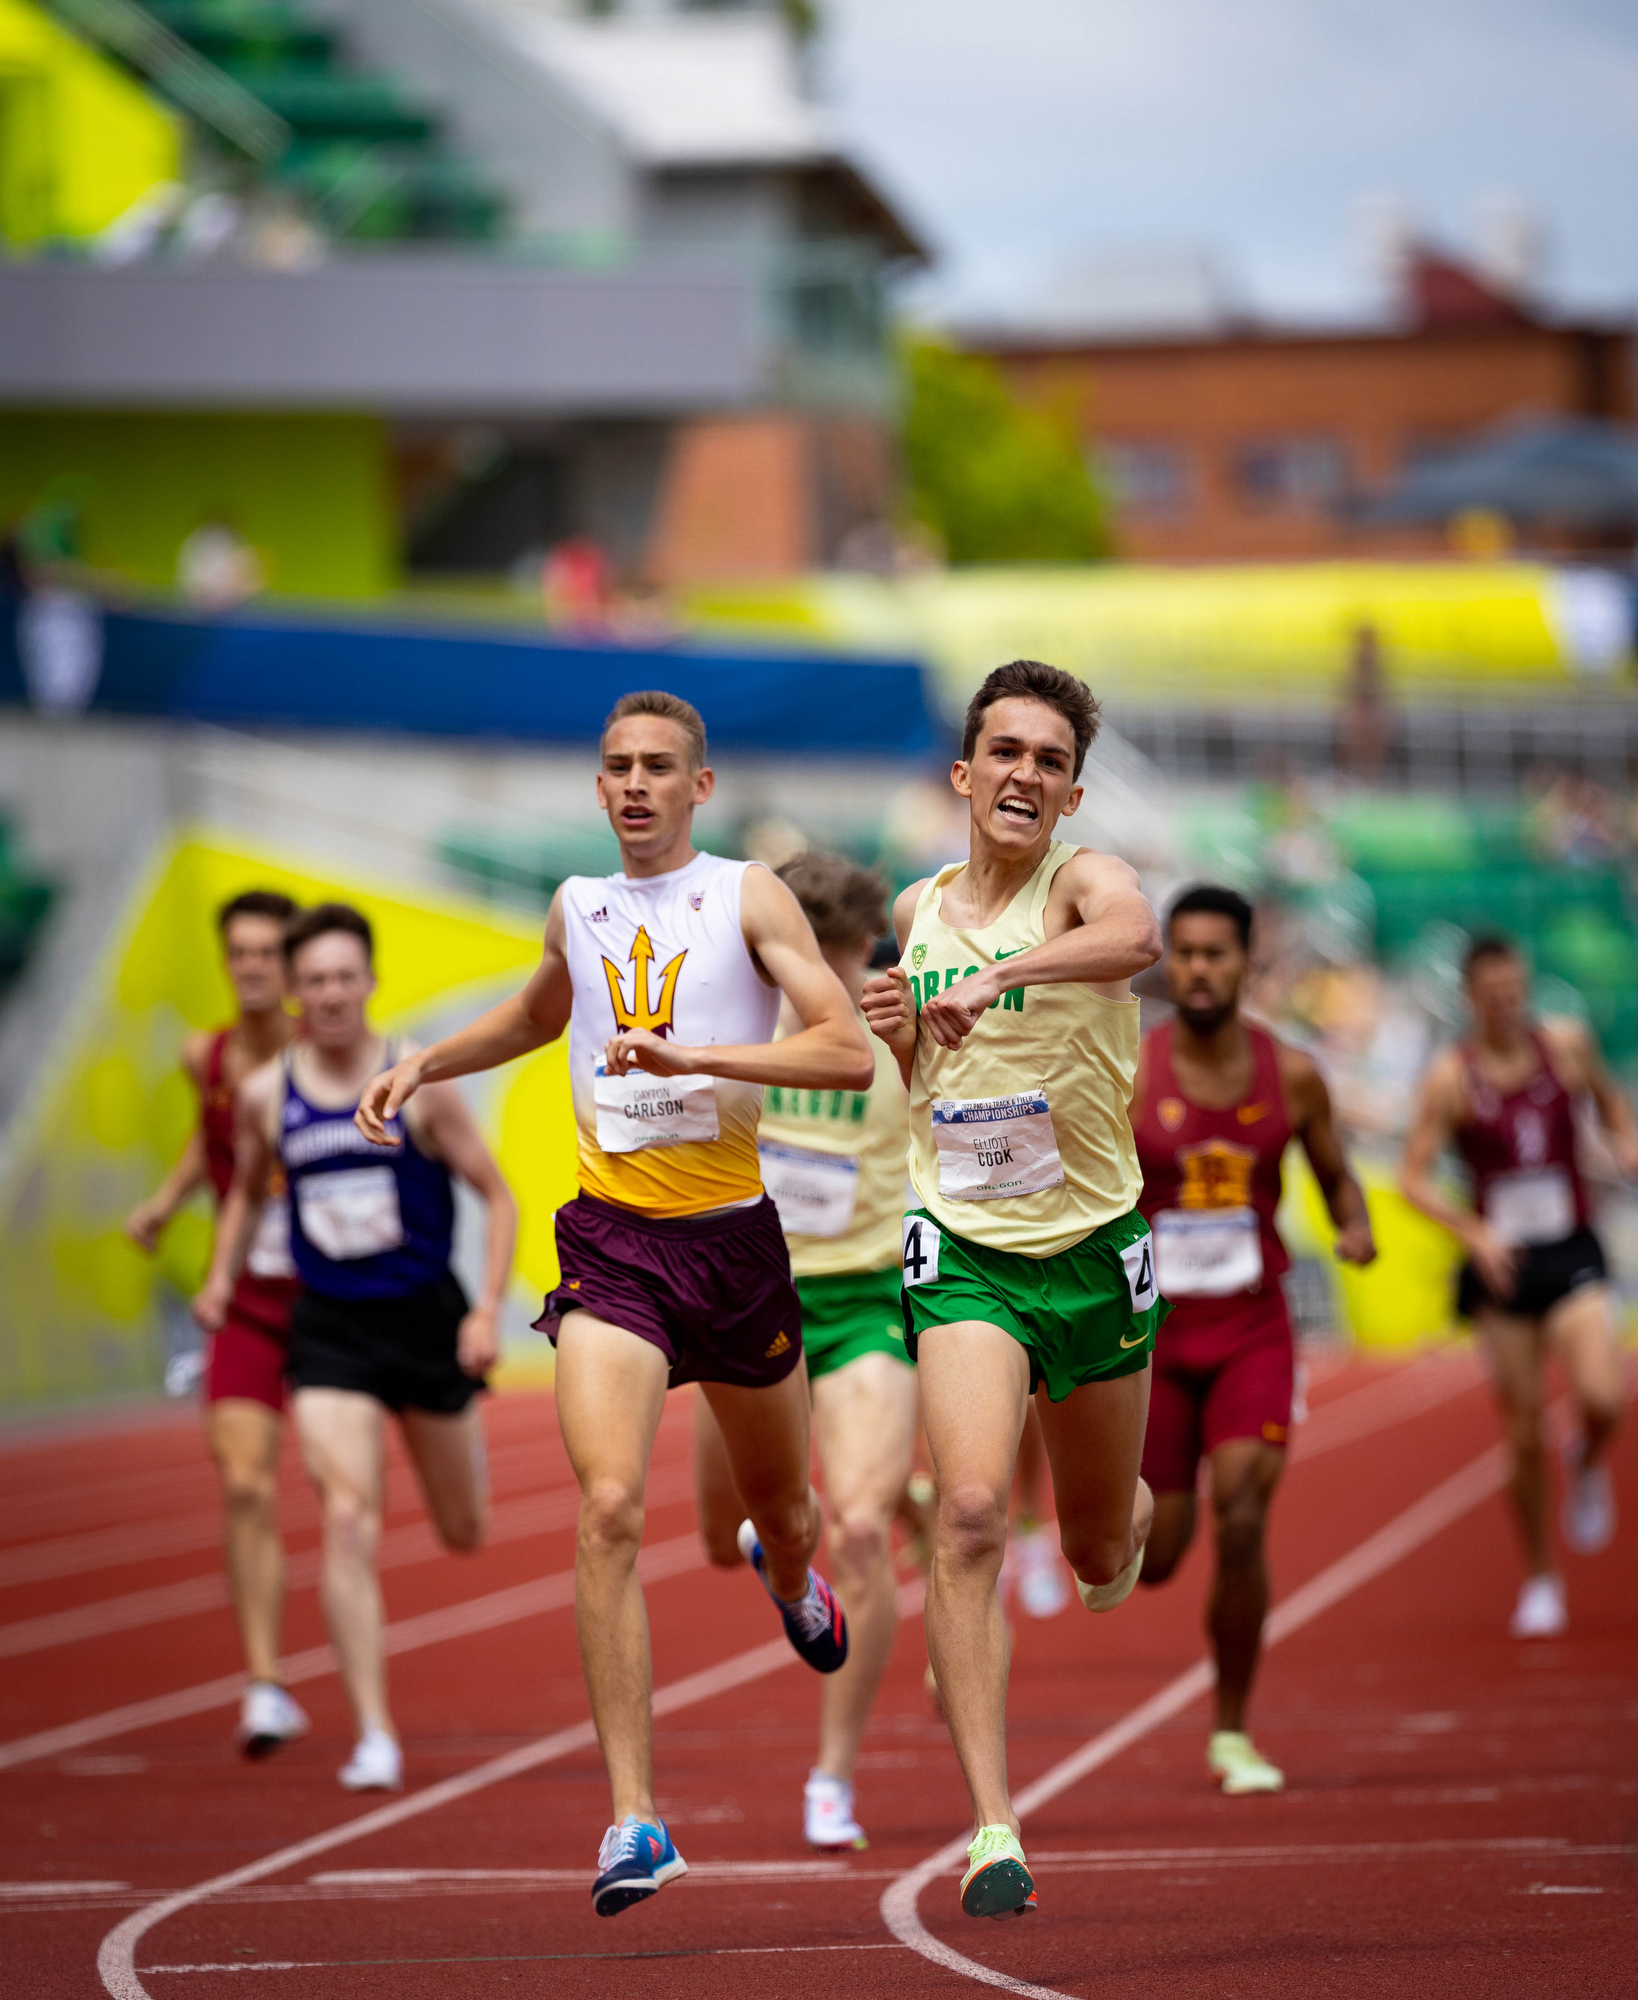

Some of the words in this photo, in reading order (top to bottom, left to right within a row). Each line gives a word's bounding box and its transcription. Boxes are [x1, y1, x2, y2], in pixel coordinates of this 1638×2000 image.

[633, 1087, 671, 1102] DAYTON
[973, 1101, 992, 1110] PAC-12
[993, 1100, 1012, 1108] TRACK
[1017, 1095, 1033, 1104] FIELD
[624, 1099, 684, 1119] CARLSON
[962, 1103, 1035, 1122] CHAMPIONSHIPS
[973, 1136, 1009, 1151] ELLIOTT
[977, 1149, 1014, 1167] COOK
[904, 1222, 927, 1279] 4
[1135, 1241, 1154, 1299] 4
